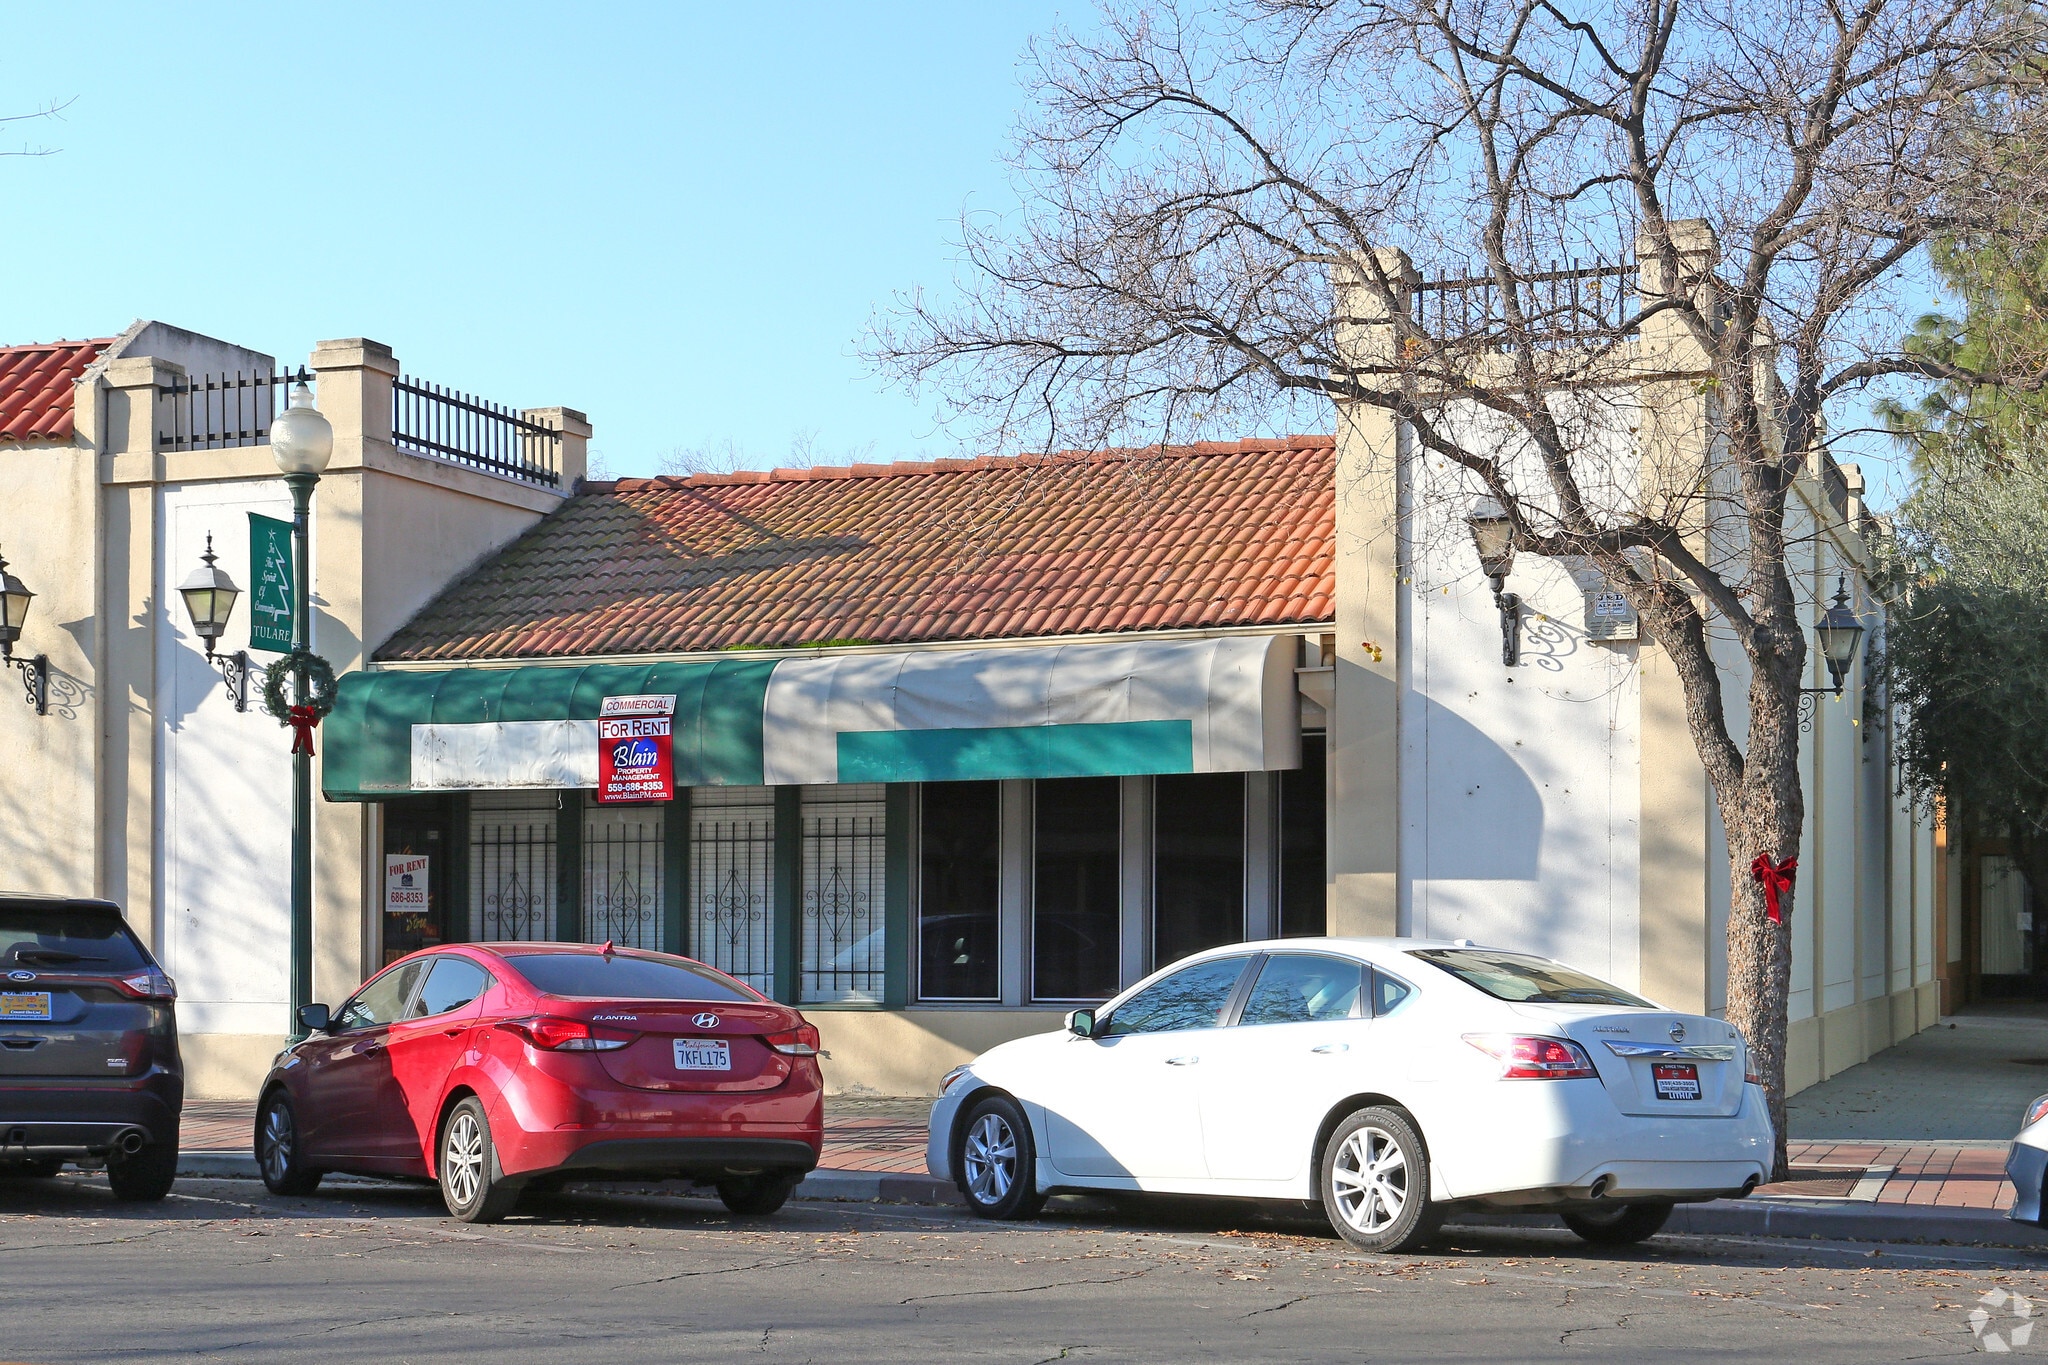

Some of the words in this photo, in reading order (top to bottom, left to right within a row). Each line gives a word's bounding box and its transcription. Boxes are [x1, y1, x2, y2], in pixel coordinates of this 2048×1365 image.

[254, 626, 290, 641] TULARE
[606, 700, 669, 711] COMMERCIAL
[602, 722, 628, 737] FOR
[633, 720, 668, 735] RENT
[614, 741, 657, 766] Blain
[612, 773, 659, 781] MANAGEMENT
[607, 782, 663, 792] 559-686-8353
[605, 791, 667, 800] www.BlainPM.com
[389, 863, 405, 877] FOR
[406, 858, 427, 873] RENT
[390, 891, 424, 903] 686-8353
[1592, 1025, 1630, 1034] ALTIMA
[684, 1041, 716, 1050] California
[678, 1050, 727, 1065] 7KFL175
[1668, 1092, 1694, 1100] LITHIA
[1366, 1115, 1401, 1136] MICHELIN
